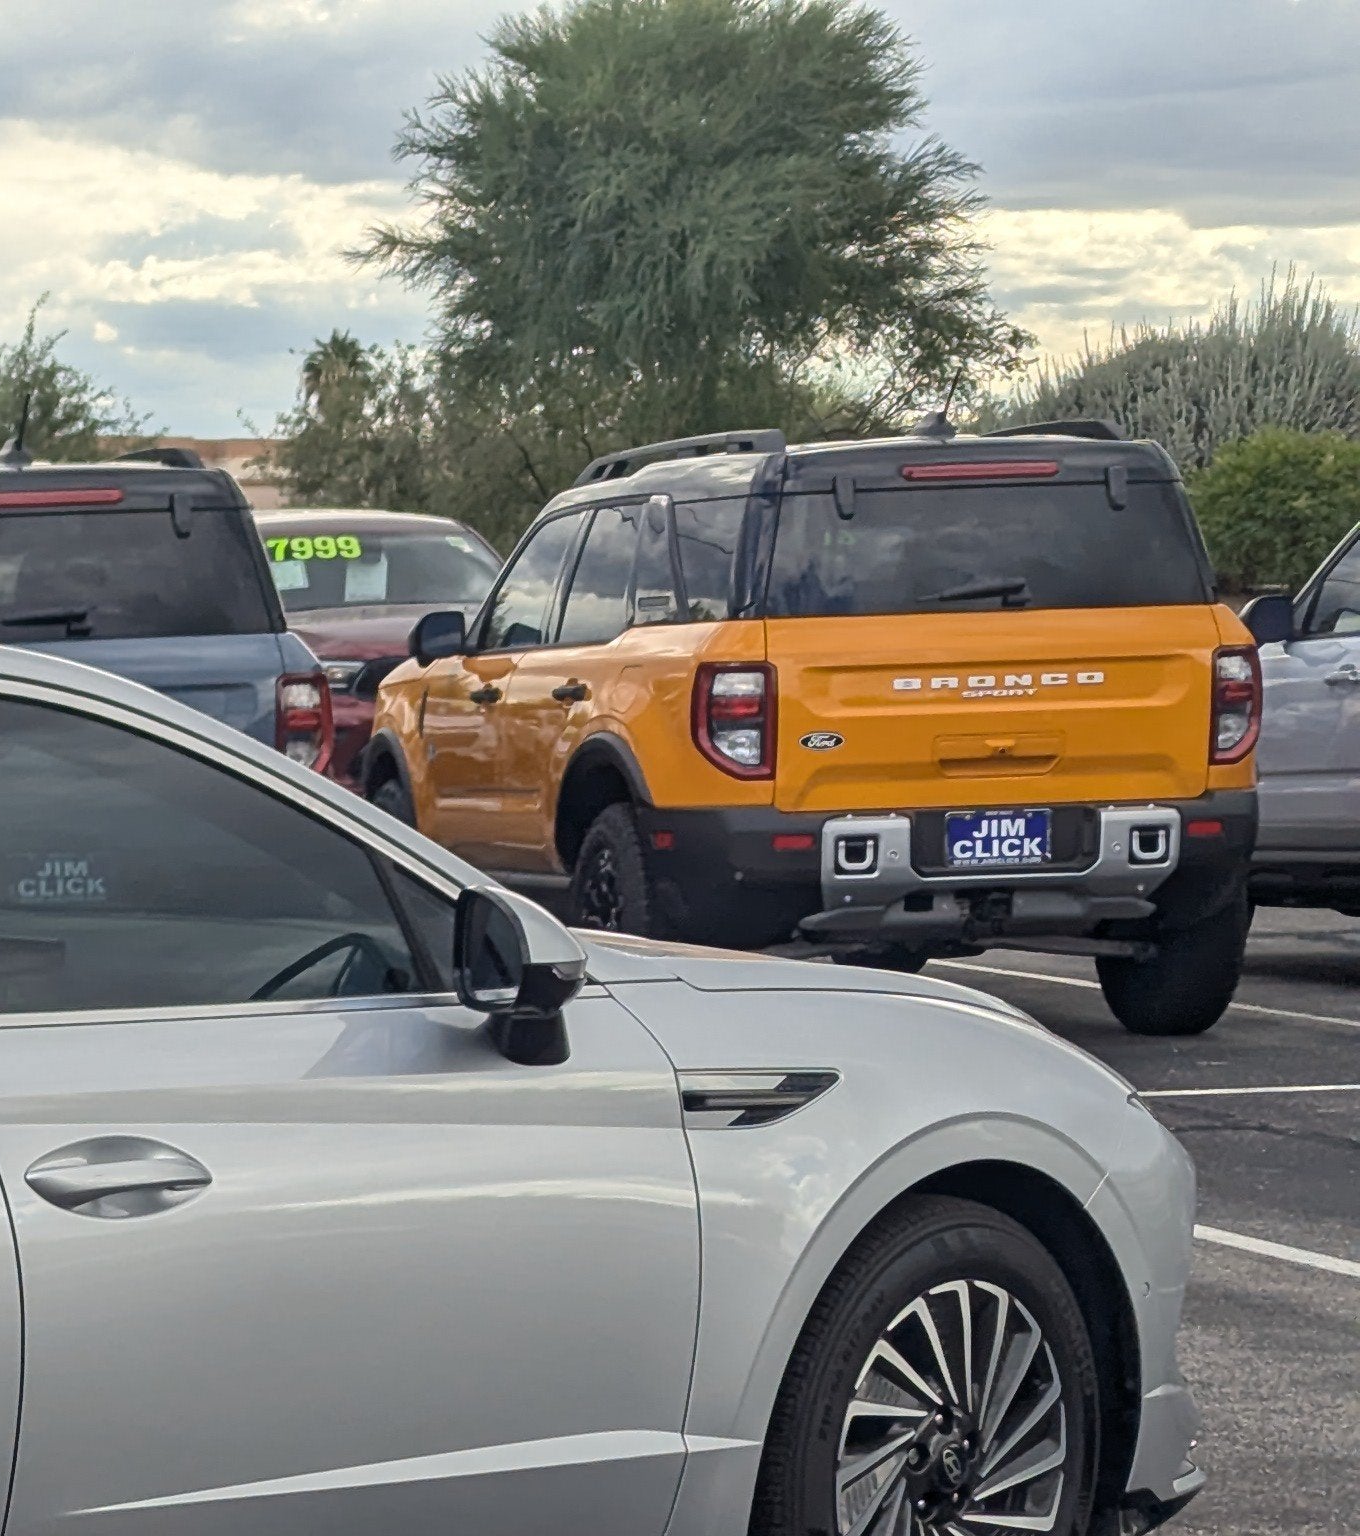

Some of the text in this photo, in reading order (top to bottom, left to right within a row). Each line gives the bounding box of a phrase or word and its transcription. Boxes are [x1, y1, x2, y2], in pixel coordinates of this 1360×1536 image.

[266, 535, 362, 562] 7999
[892, 672, 1105, 690] BRONCO
[961, 687, 1038, 698] SPORT
[803, 733, 839, 748] Ford
[972, 818, 1026, 838] JIM
[953, 837, 1043, 859] CLICK
[37, 861, 88, 877] JIM
[17, 878, 106, 897] CLICK
